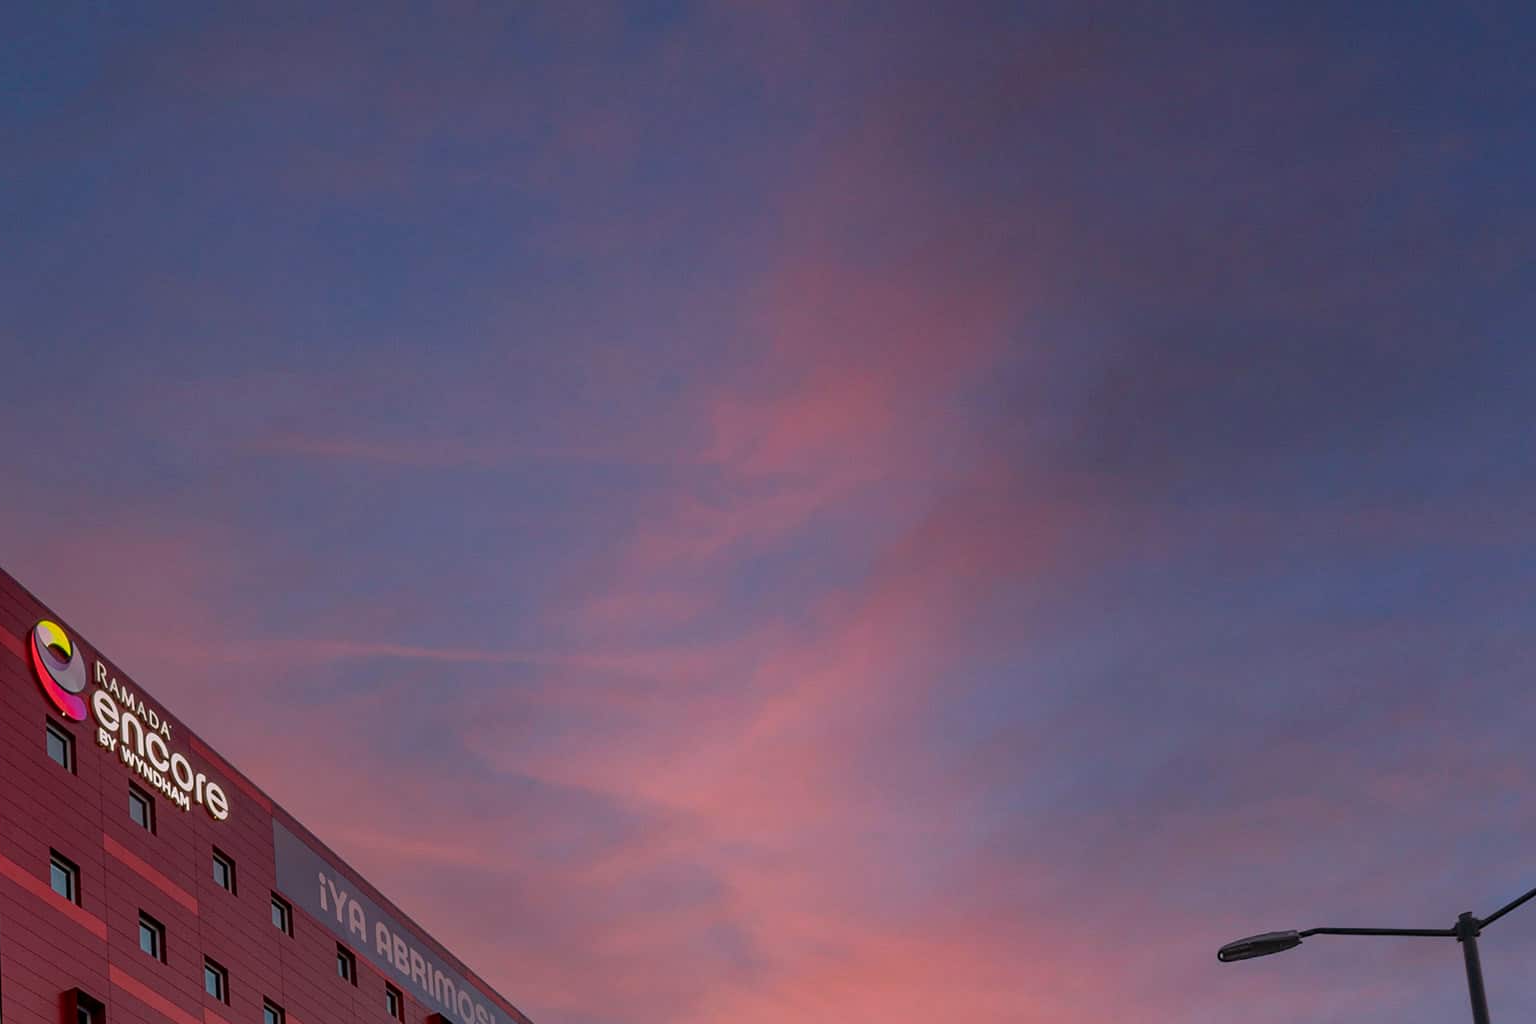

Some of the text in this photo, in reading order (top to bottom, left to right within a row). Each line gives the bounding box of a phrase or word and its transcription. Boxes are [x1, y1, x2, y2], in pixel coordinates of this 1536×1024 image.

[96, 660, 170, 740] RAMADA
[93, 689, 229, 820] encore
[99, 728, 190, 811] BY WYNDHAM
